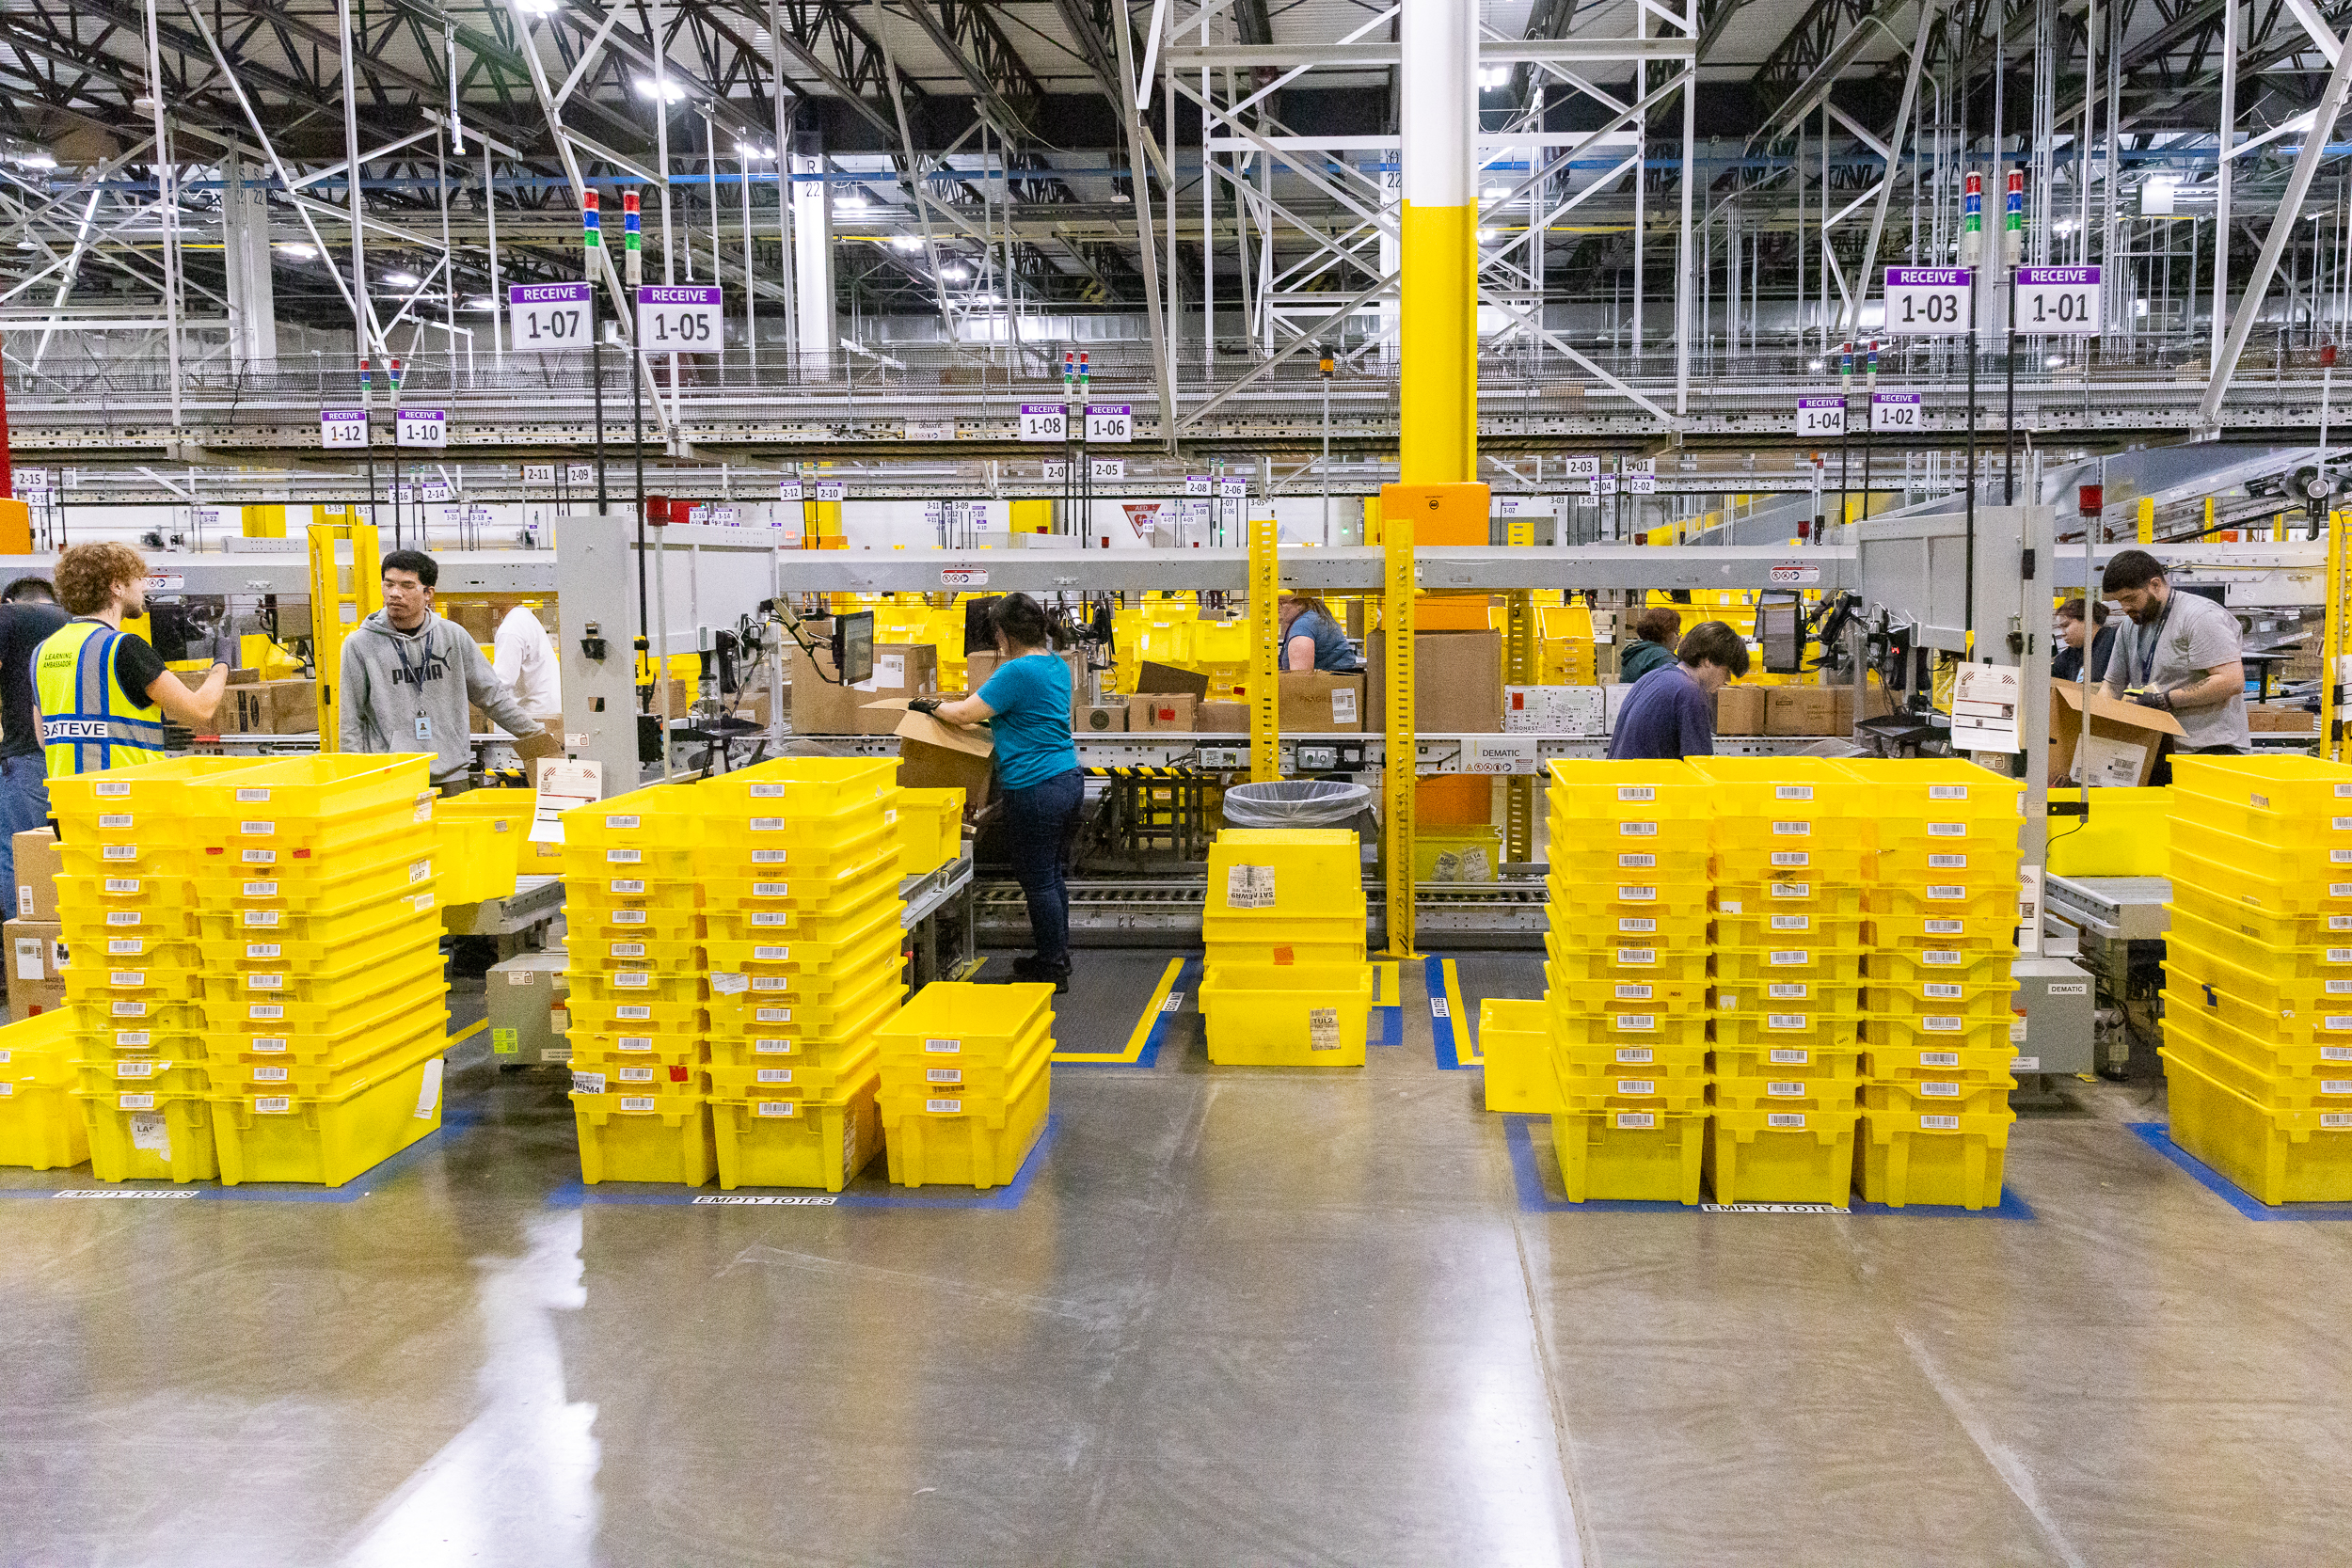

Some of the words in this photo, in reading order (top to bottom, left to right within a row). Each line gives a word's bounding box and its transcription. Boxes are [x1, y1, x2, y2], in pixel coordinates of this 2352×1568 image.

[807, 161, 815, 173] R
[1988, 164, 2002, 179] 2
[1387, 173, 1400, 187] 22
[806, 182, 819, 197] 22
[254, 190, 262, 205] 22
[1901, 271, 1956, 283] RECEIVE
[2031, 270, 2087, 282] RECEIVE
[524, 287, 577, 300] RECEIVE
[652, 290, 707, 301] RECEIVE
[1902, 294, 1957, 323] 1-03
[2033, 294, 2088, 322] 1-01
[527, 311, 580, 339] 1-07
[655, 313, 710, 341] 1-05
[1808, 412, 1840, 428] 1-04
[1882, 408, 1913, 424] 1-02
[1030, 418, 1061, 434] 1-08
[1094, 420, 1124, 436] 1-06
[331, 426, 361, 441] 1-12
[407, 425, 438, 440] 1-10
[1049, 466, 1069, 477] 2-0
[1096, 464, 1117, 475] 2-05
[1571, 461, 1592, 473] 2-03
[20, 474, 41, 484] 2-15
[529, 469, 549, 479] 2-11
[572, 470, 589, 481] 2-09
[1190, 484, 1207, 492] 2-08
[1224, 486, 1241, 494] 2-06
[1594, 483, 1611, 491] 204
[1634, 482, 1650, 490] 2-02
[427, 490, 445, 498] 2-14
[575, 1082, 600, 1093] MEM4
[1706, 1204, 1774, 1212] EMPTY
[1779, 1205, 1848, 1213] TOTES
